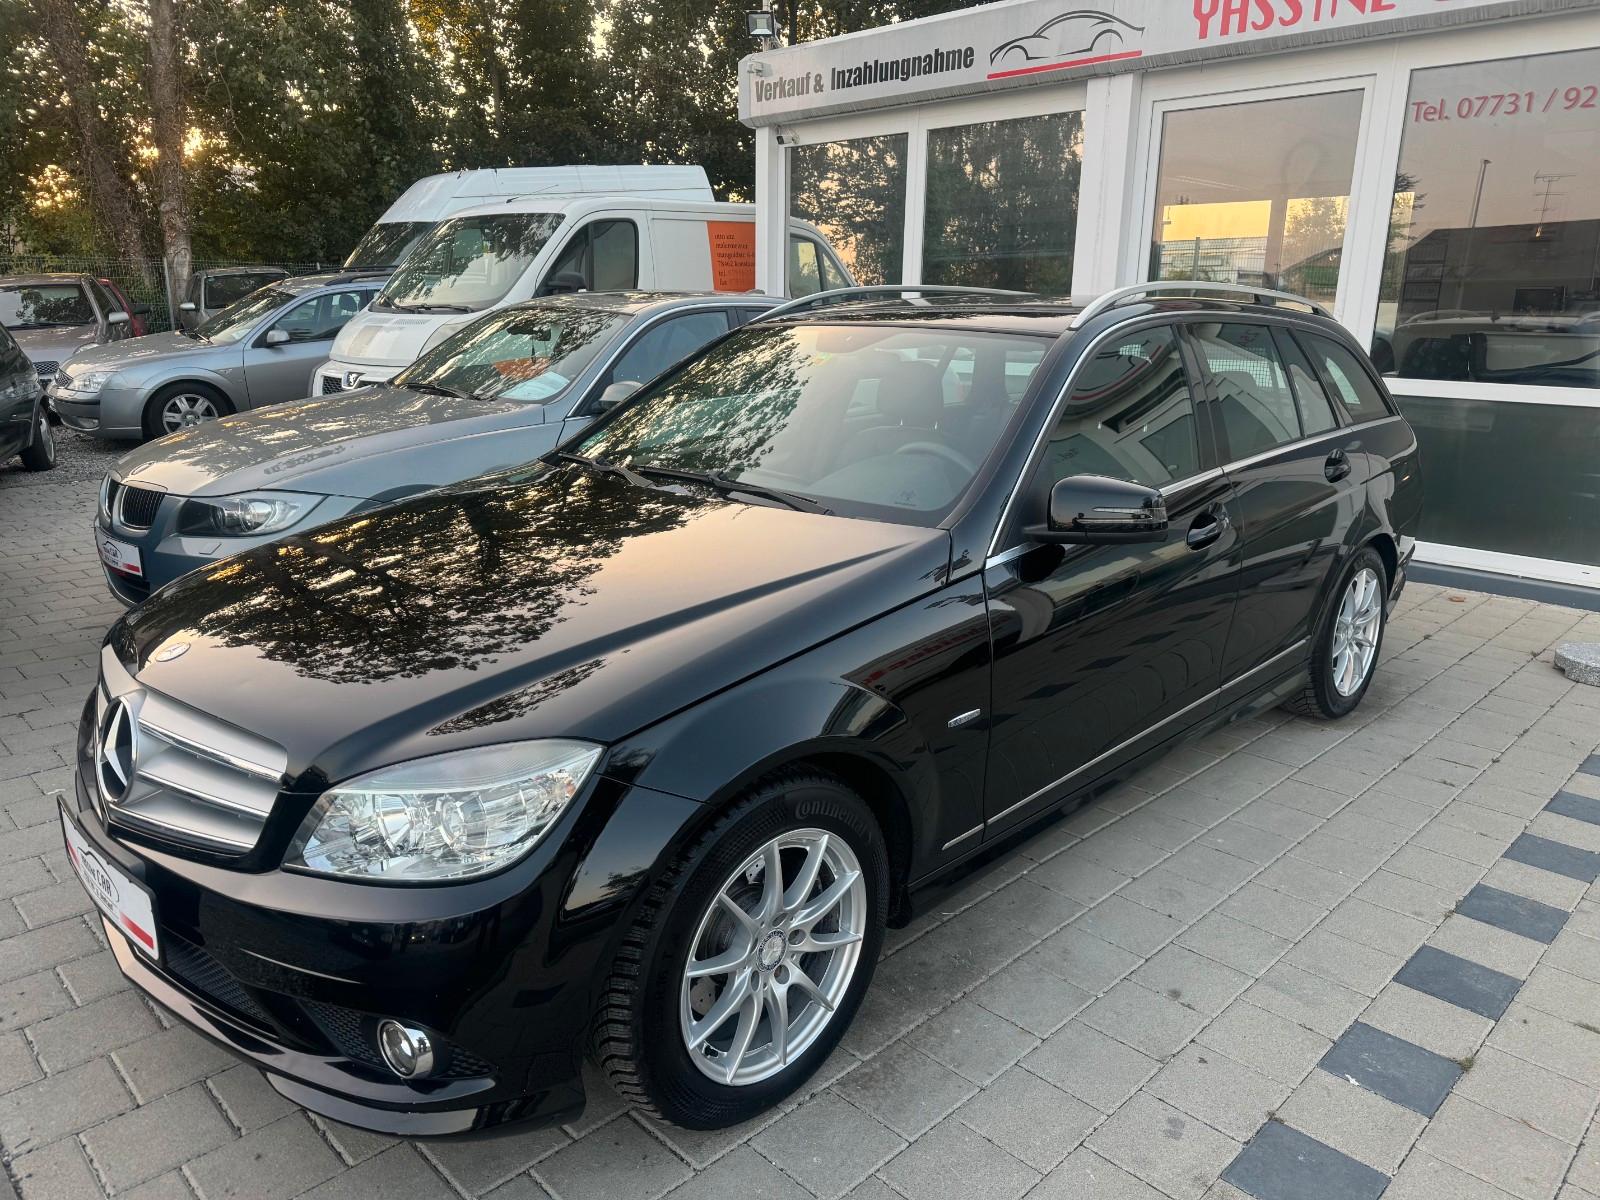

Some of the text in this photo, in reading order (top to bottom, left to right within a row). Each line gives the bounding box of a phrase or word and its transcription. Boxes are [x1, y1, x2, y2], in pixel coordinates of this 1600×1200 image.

[755, 46, 975, 102] Verkauf & Inzahlungnahme
[1412, 85, 1599, 122] Tel. 07731 / 92
